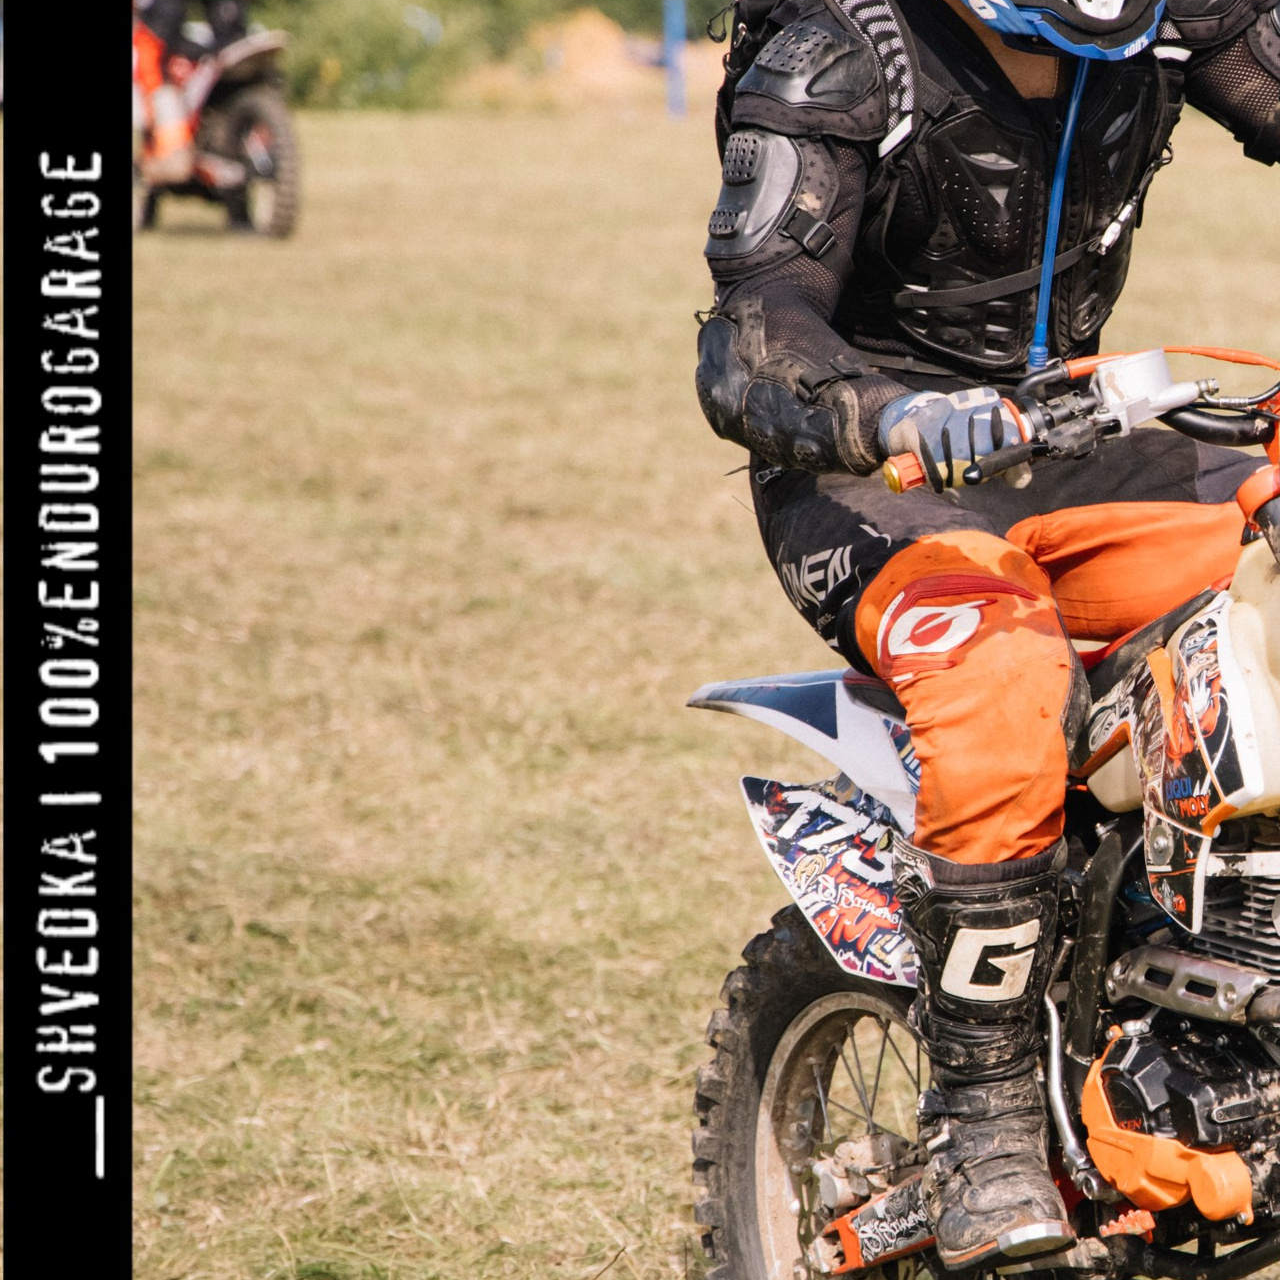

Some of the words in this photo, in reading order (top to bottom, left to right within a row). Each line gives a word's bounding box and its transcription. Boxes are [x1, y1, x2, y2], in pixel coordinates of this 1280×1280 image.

[1123, 34, 1149, 58] 100%
[1166, 777, 1192, 800] LIQUI
[1176, 794, 1211, 818] MOLY
[940, 918, 1040, 1002] G
